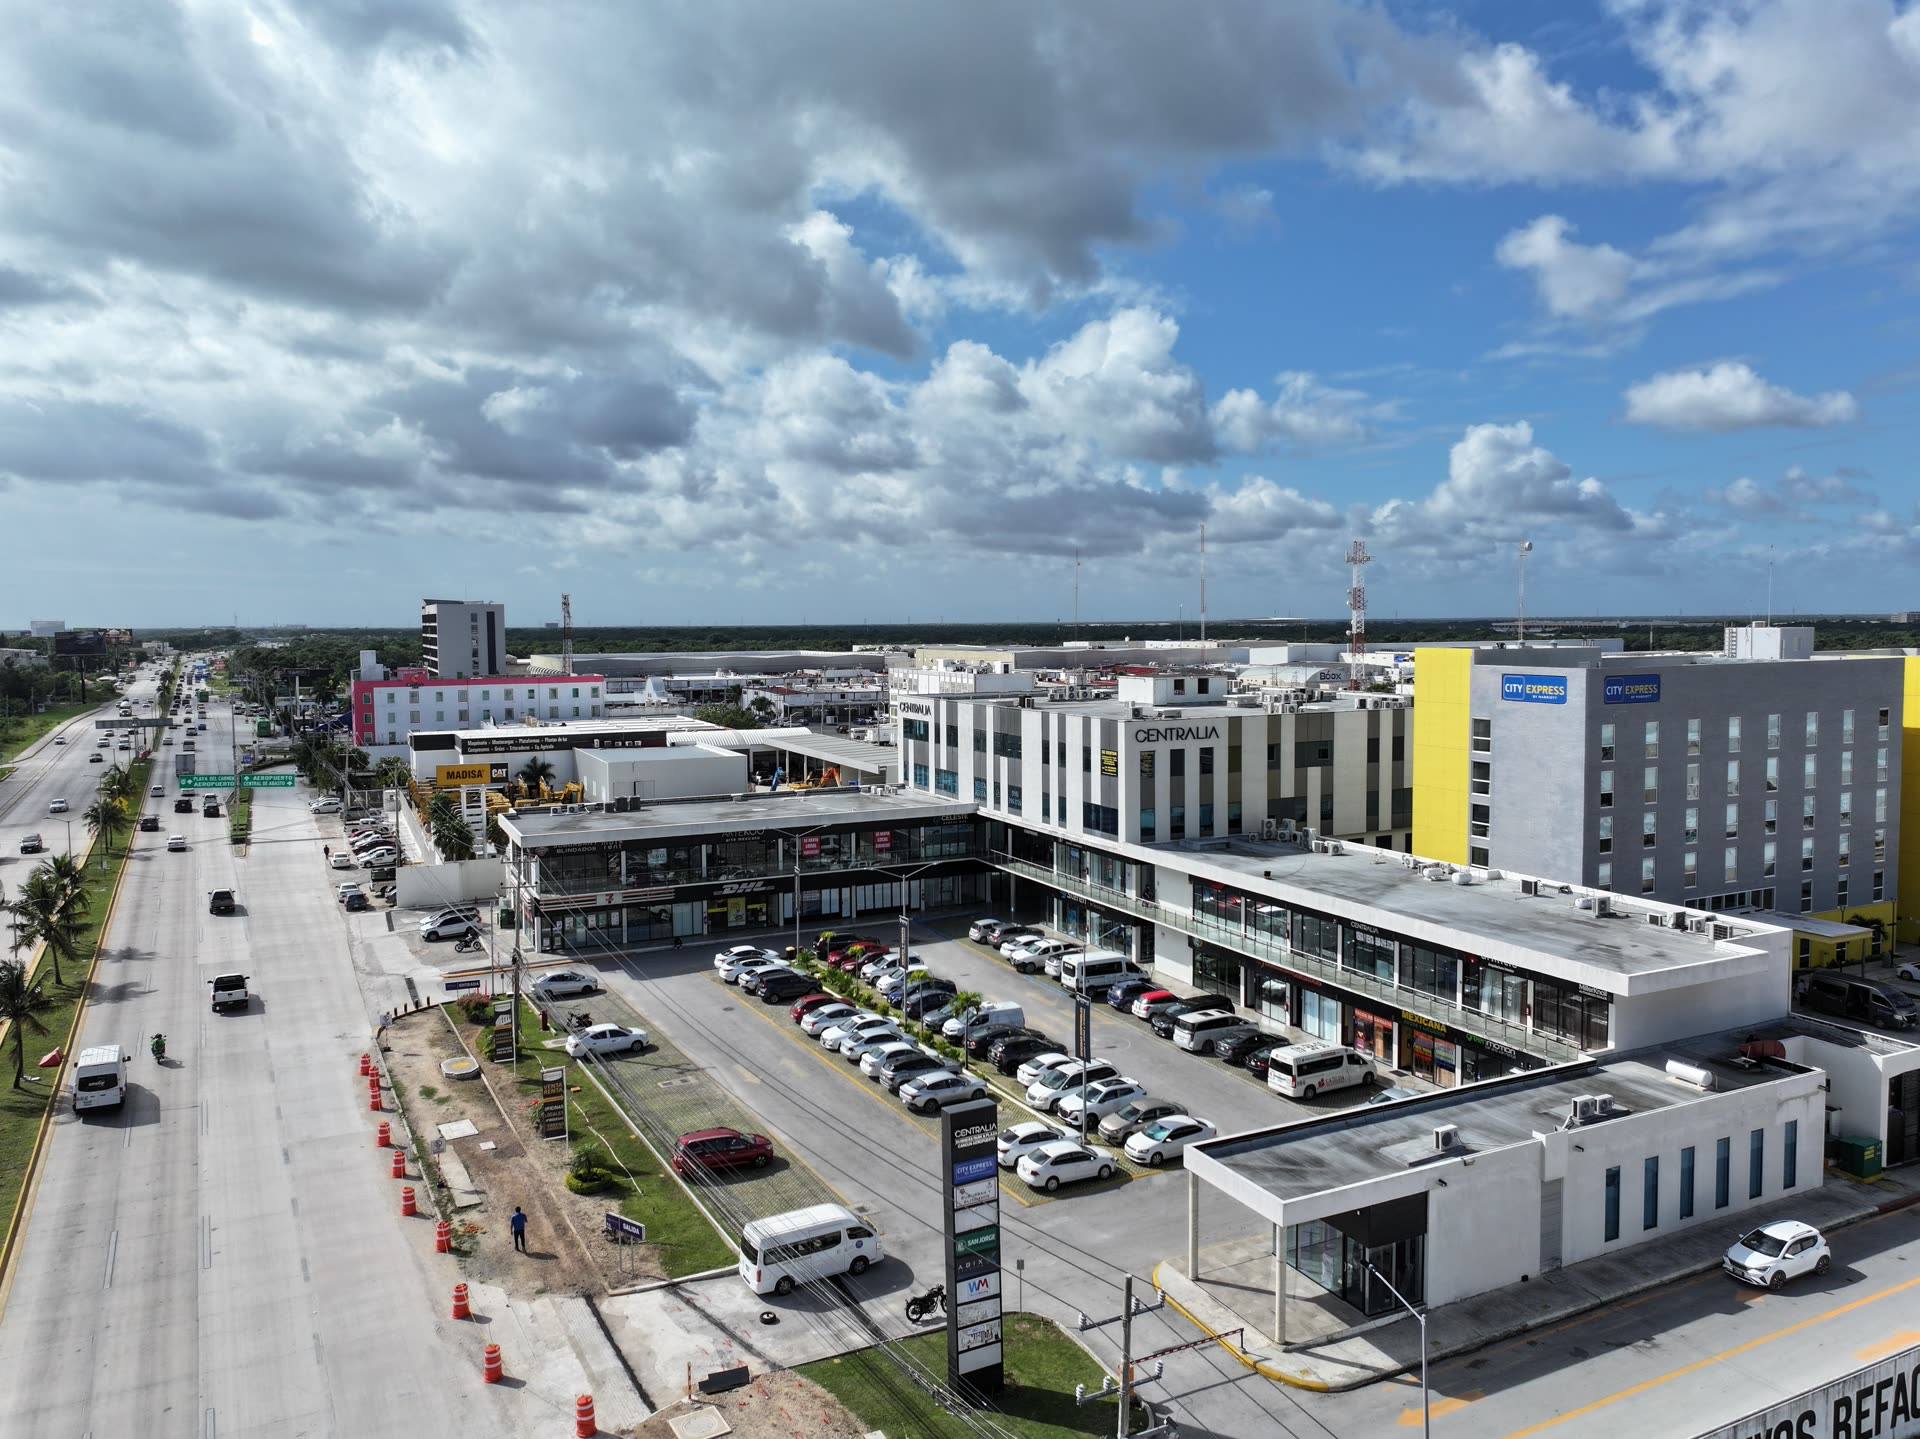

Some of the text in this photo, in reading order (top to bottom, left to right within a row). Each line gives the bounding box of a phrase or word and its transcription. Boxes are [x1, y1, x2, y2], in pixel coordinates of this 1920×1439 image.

[1505, 683, 1565, 696] CITY EXPRESS
[1606, 684, 1657, 696] CITY EXPRESS
[900, 702, 931, 716] CENTRALIA
[1135, 726, 1219, 743] CENTRALIA
[446, 769, 483, 780] MADISA
[491, 768, 507, 778] CAT
[556, 846, 597, 854] BLINDADOS
[721, 881, 767, 895] DHL
[1350, 921, 1379, 934] CENTRALIA
[1401, 1010, 1447, 1034] MEXICANA
[954, 1122, 997, 1138] CENTRALIA
[957, 1160, 993, 1175] CITY EXPRESS
[622, 1222, 640, 1235] SALIDA
[967, 1233, 996, 1247] SAN JORGE
